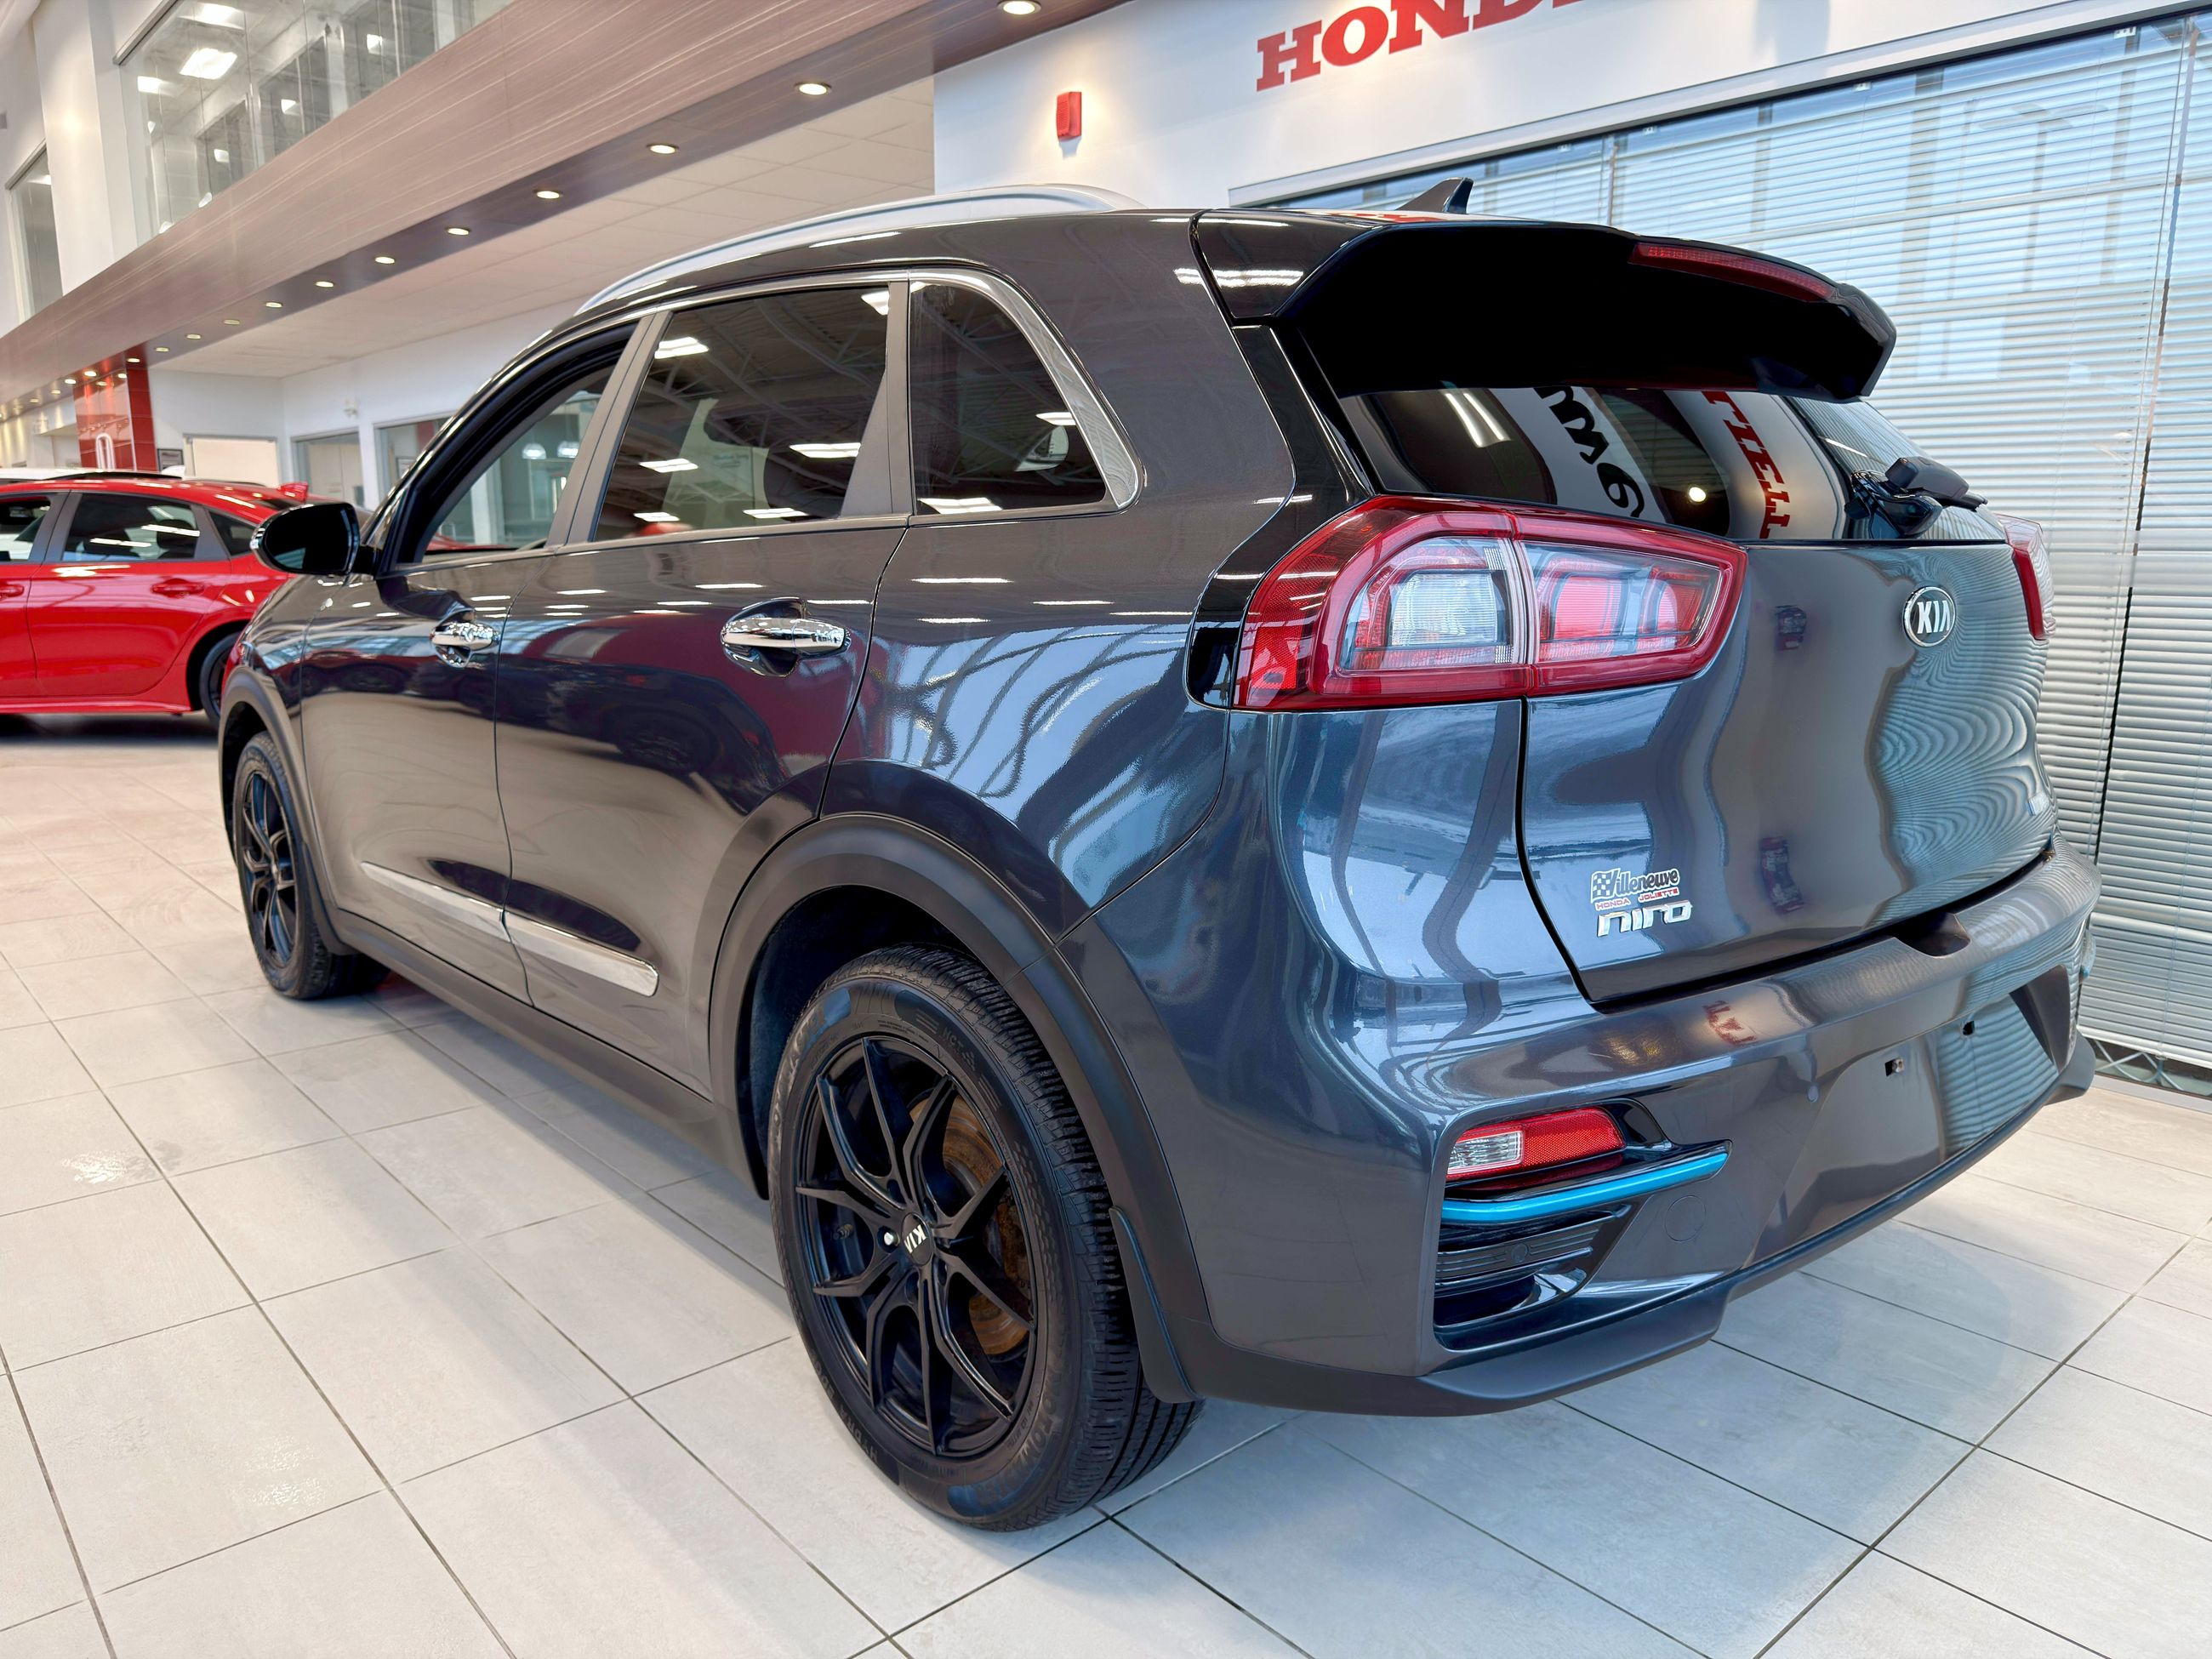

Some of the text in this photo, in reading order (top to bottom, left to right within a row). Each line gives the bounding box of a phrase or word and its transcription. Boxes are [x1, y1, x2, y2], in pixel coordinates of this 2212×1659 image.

[1257, 0, 1589, 91] HON
[1917, 600, 1951, 634] KIA
[1594, 869, 1679, 898] Villeneuve
[1596, 888, 1679, 909] HONDA JOLIETTE
[1598, 900, 1692, 937] niro
[904, 1224, 926, 1254] KIA
